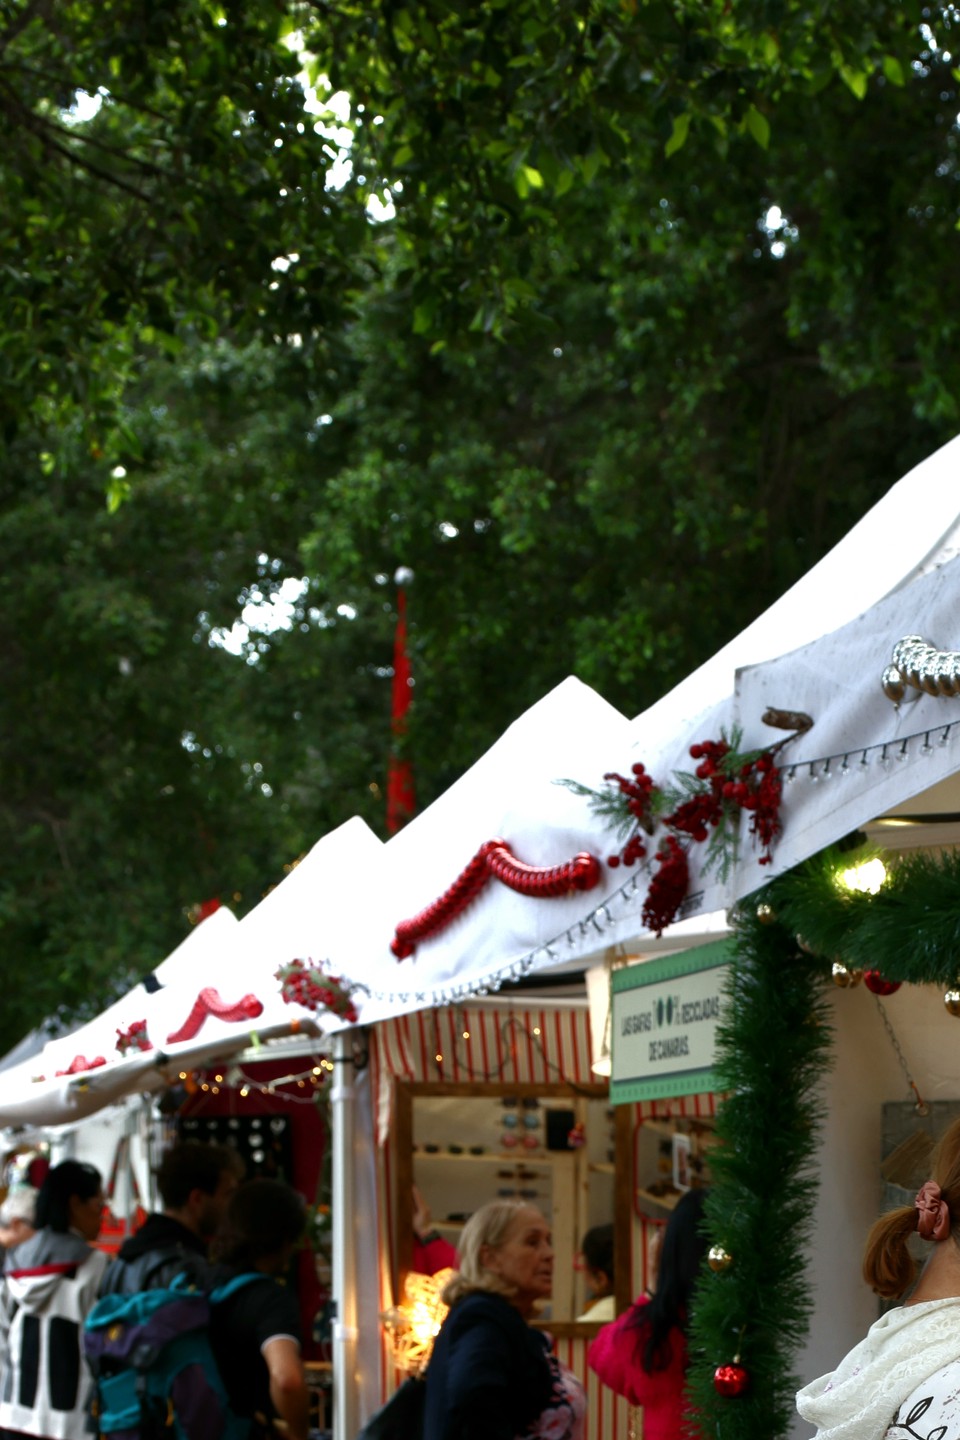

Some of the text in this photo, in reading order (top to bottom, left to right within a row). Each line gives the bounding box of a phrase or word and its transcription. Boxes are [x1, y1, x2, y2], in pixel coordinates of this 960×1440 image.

[632, 1011, 652, 1034] GAFAS
[682, 996, 719, 1025] RECICLADAS
[649, 1041, 657, 1061] DE
